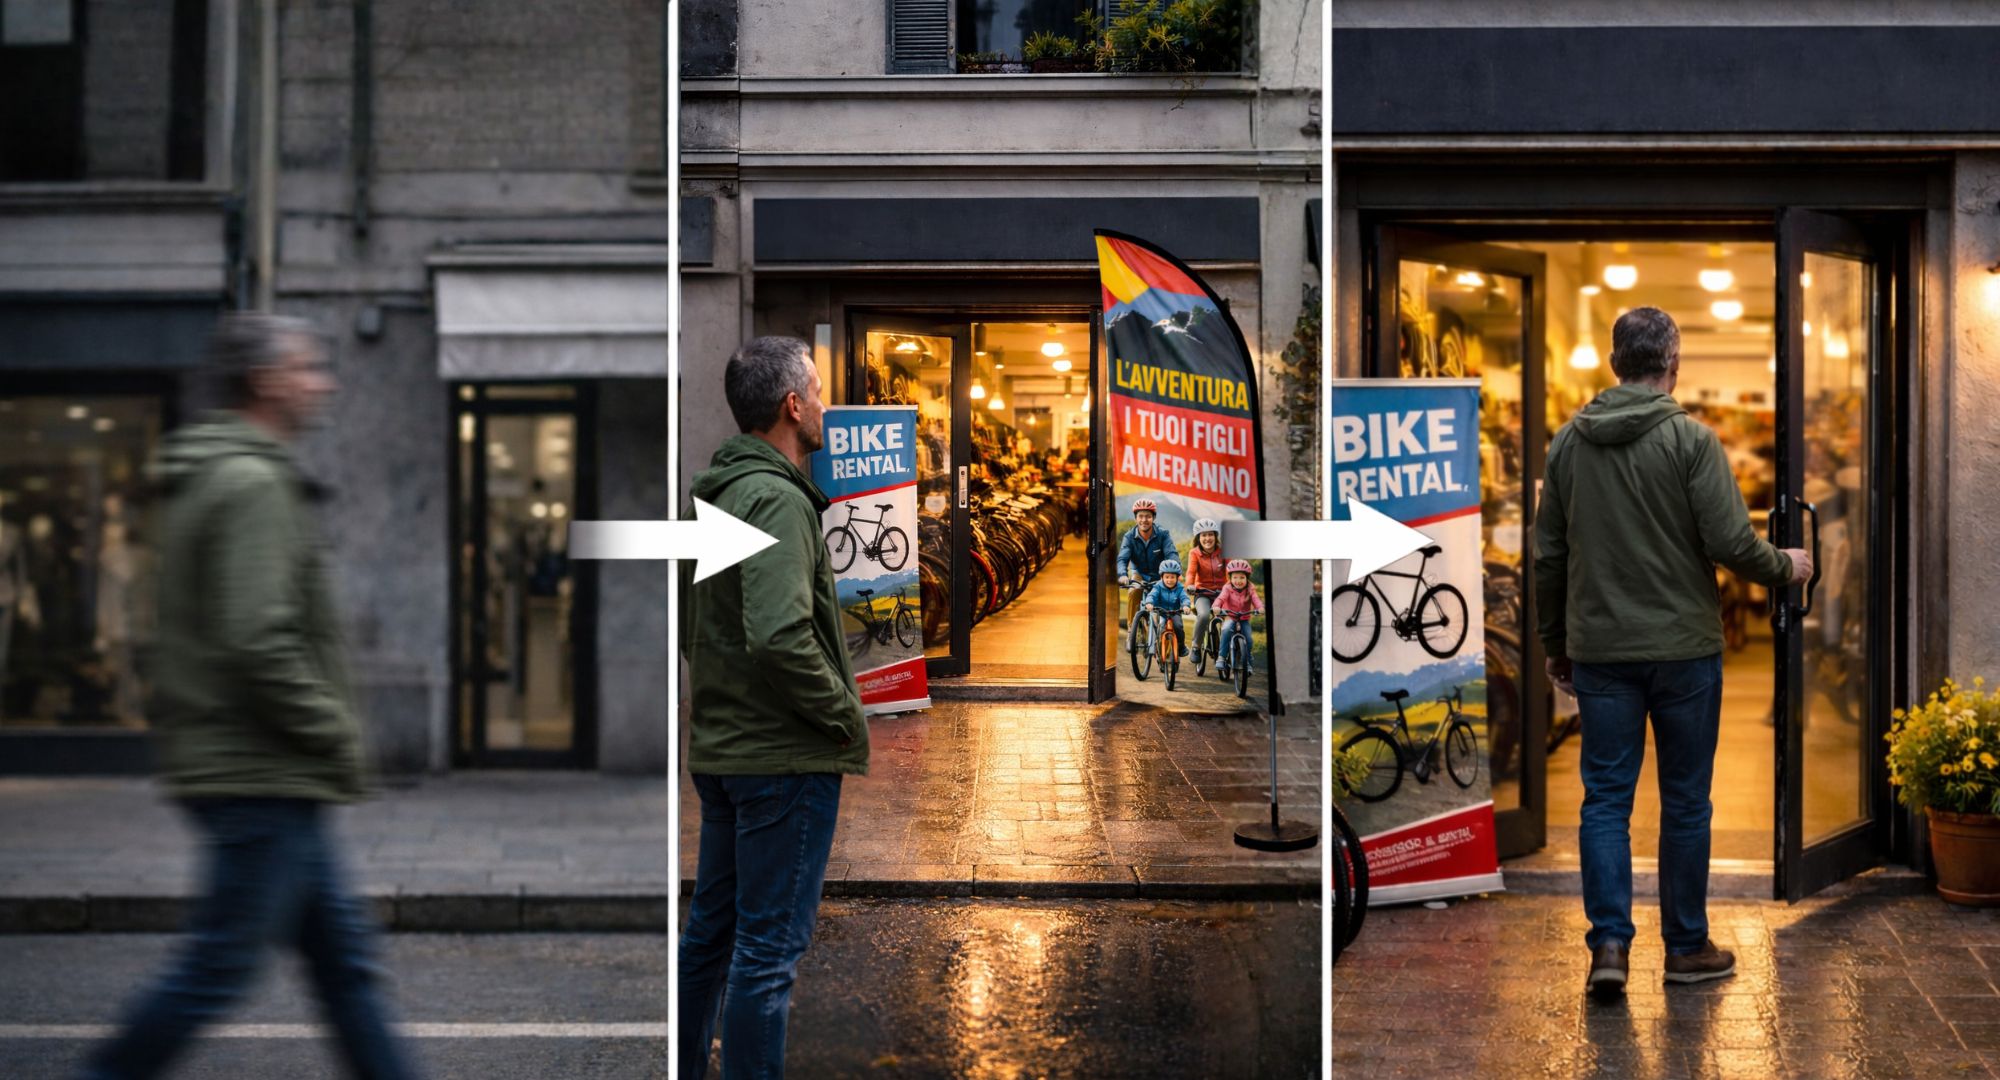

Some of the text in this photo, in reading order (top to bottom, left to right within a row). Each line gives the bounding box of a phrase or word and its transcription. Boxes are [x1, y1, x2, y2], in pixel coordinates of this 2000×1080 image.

[1116, 358, 1249, 411] L'AVVENTURA
[828, 422, 904, 455] BIKE
[1125, 405, 1247, 457] I TUOI FIGLI
[1332, 408, 1457, 464] BIKE
[1121, 444, 1250, 499] AMERANNO
